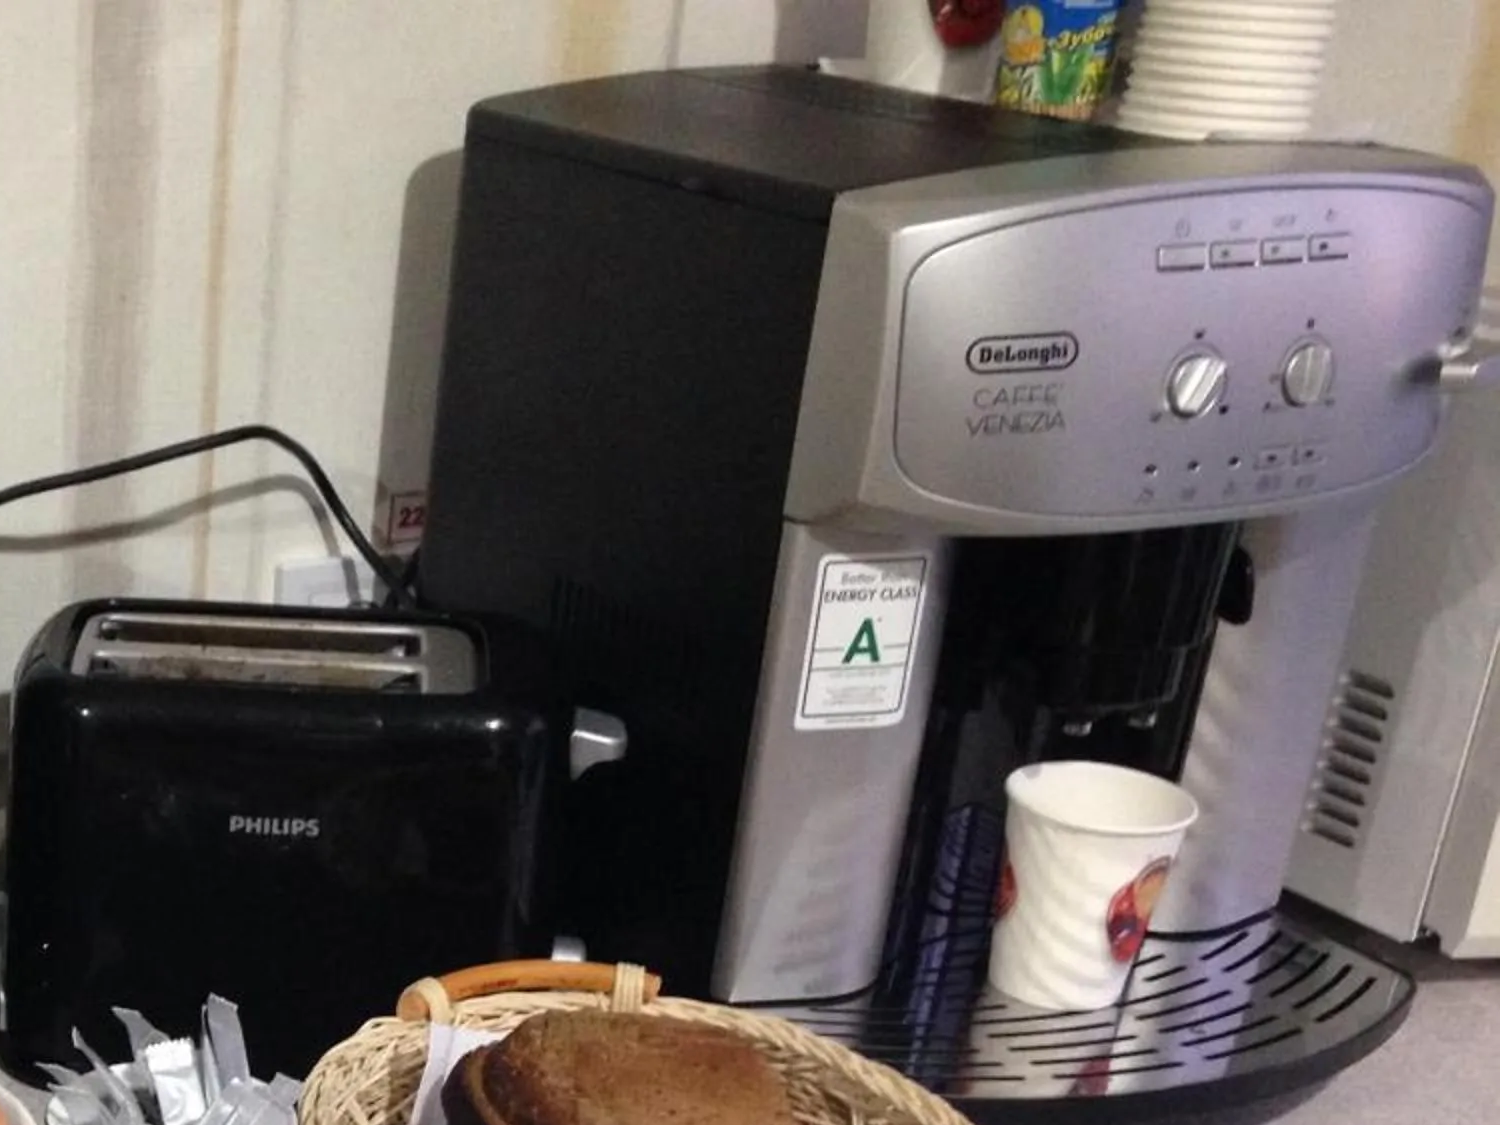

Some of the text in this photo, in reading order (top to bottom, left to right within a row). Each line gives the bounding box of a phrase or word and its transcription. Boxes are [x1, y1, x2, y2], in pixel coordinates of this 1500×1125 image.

[965, 409, 1067, 437] VENEZIA
[399, 506, 427, 529] 22
[823, 584, 918, 604] ENERGY CLASS
[841, 617, 881, 664] A
[229, 815, 321, 837] PHILIPS
